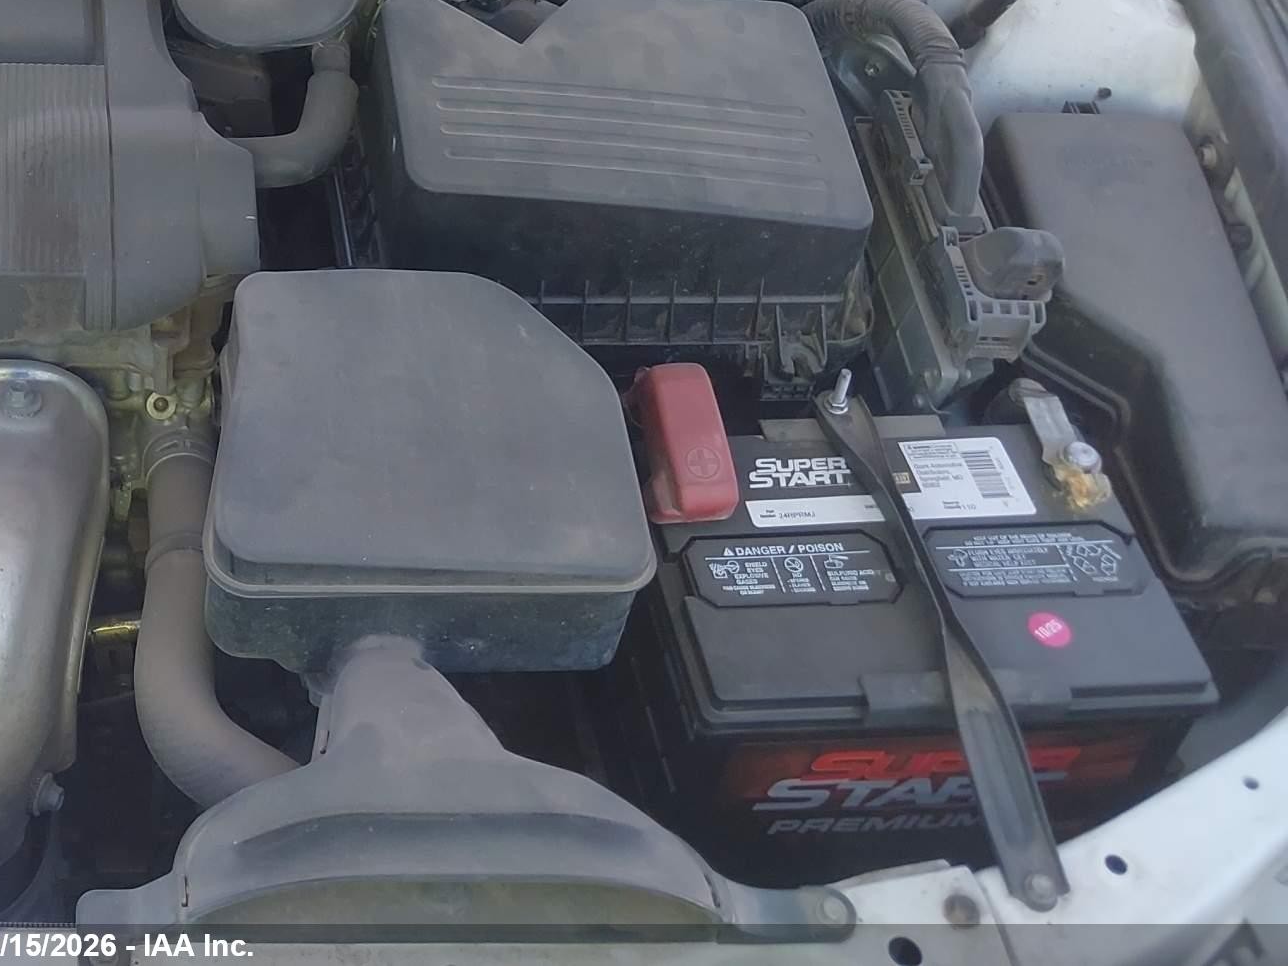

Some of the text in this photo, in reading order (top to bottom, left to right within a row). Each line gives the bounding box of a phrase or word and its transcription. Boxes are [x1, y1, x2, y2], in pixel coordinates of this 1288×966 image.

[755, 457, 847, 473] SUPER
[749, 470, 851, 488] START
[735, 545, 786, 556] DANGER
[798, 542, 844, 553] POISON
[802, 746, 1081, 779] SUPR
[753, 771, 1067, 811] STAR
